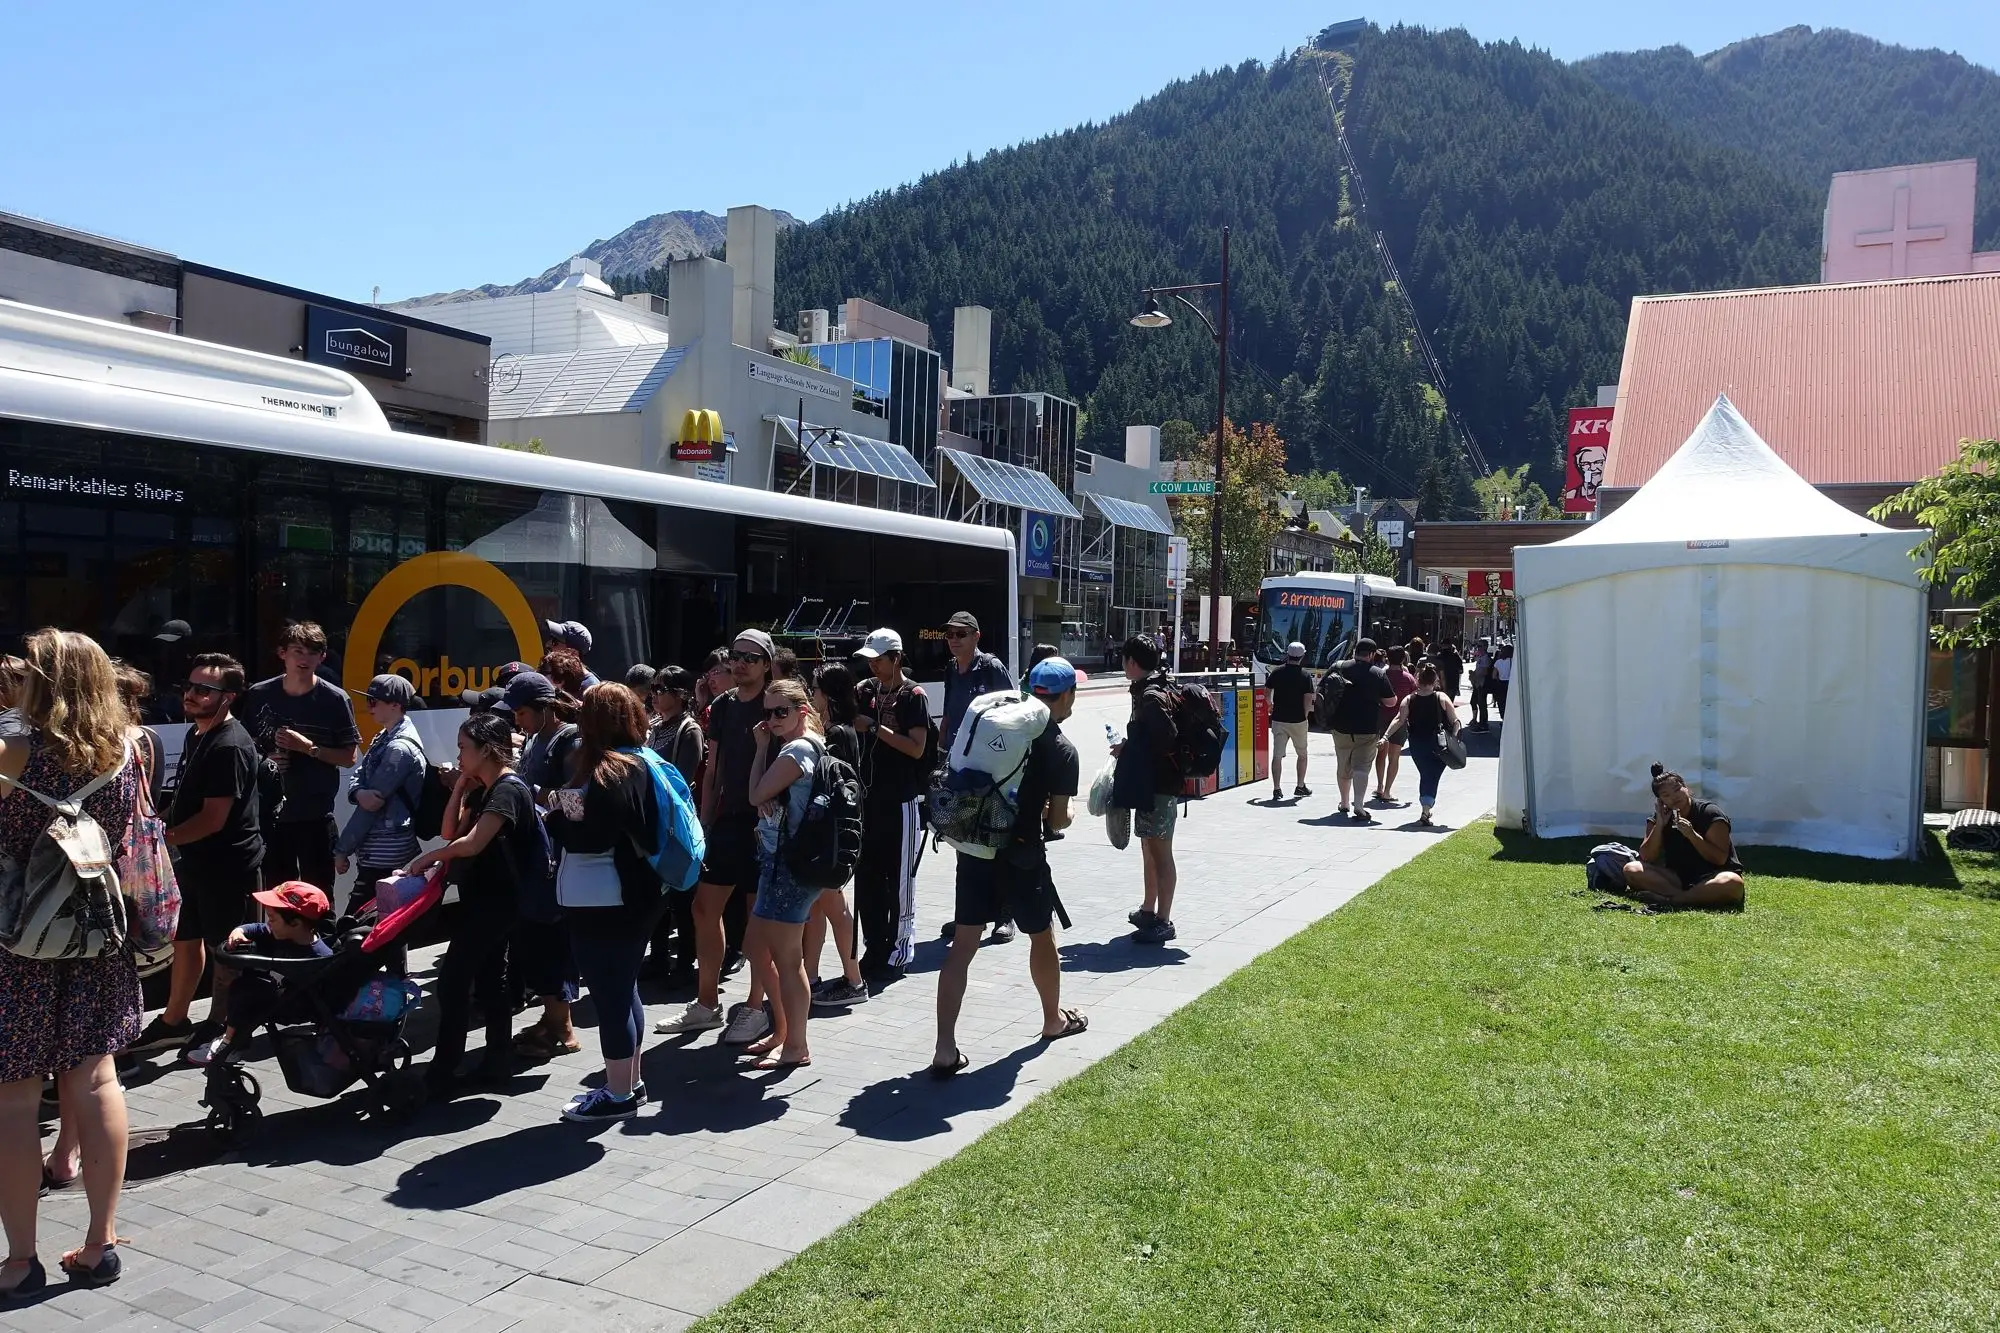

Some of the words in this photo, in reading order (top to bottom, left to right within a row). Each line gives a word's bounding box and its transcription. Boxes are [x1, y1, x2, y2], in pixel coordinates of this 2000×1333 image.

[329, 336, 389, 359] bungalow
[756, 366, 783, 384] Language
[784, 374, 805, 388] Schools
[806, 381, 818, 391] New
[820, 385, 840, 397] Zealand
[261, 396, 300, 410] THERMO
[301, 403, 322, 413] KING
[9, 469, 127, 497] Remarkables
[134, 482, 184, 502] Shops
[1160, 483, 1182, 493] COW
[1187, 483, 1211, 492] LANE
[1027, 559, 1050, 570] O'Connells
[1281, 592, 1289, 605] 2
[1290, 593, 1344, 608] Arrowtown
[919, 629, 948, 640] #Better
[388, 655, 501, 698] Orbu
